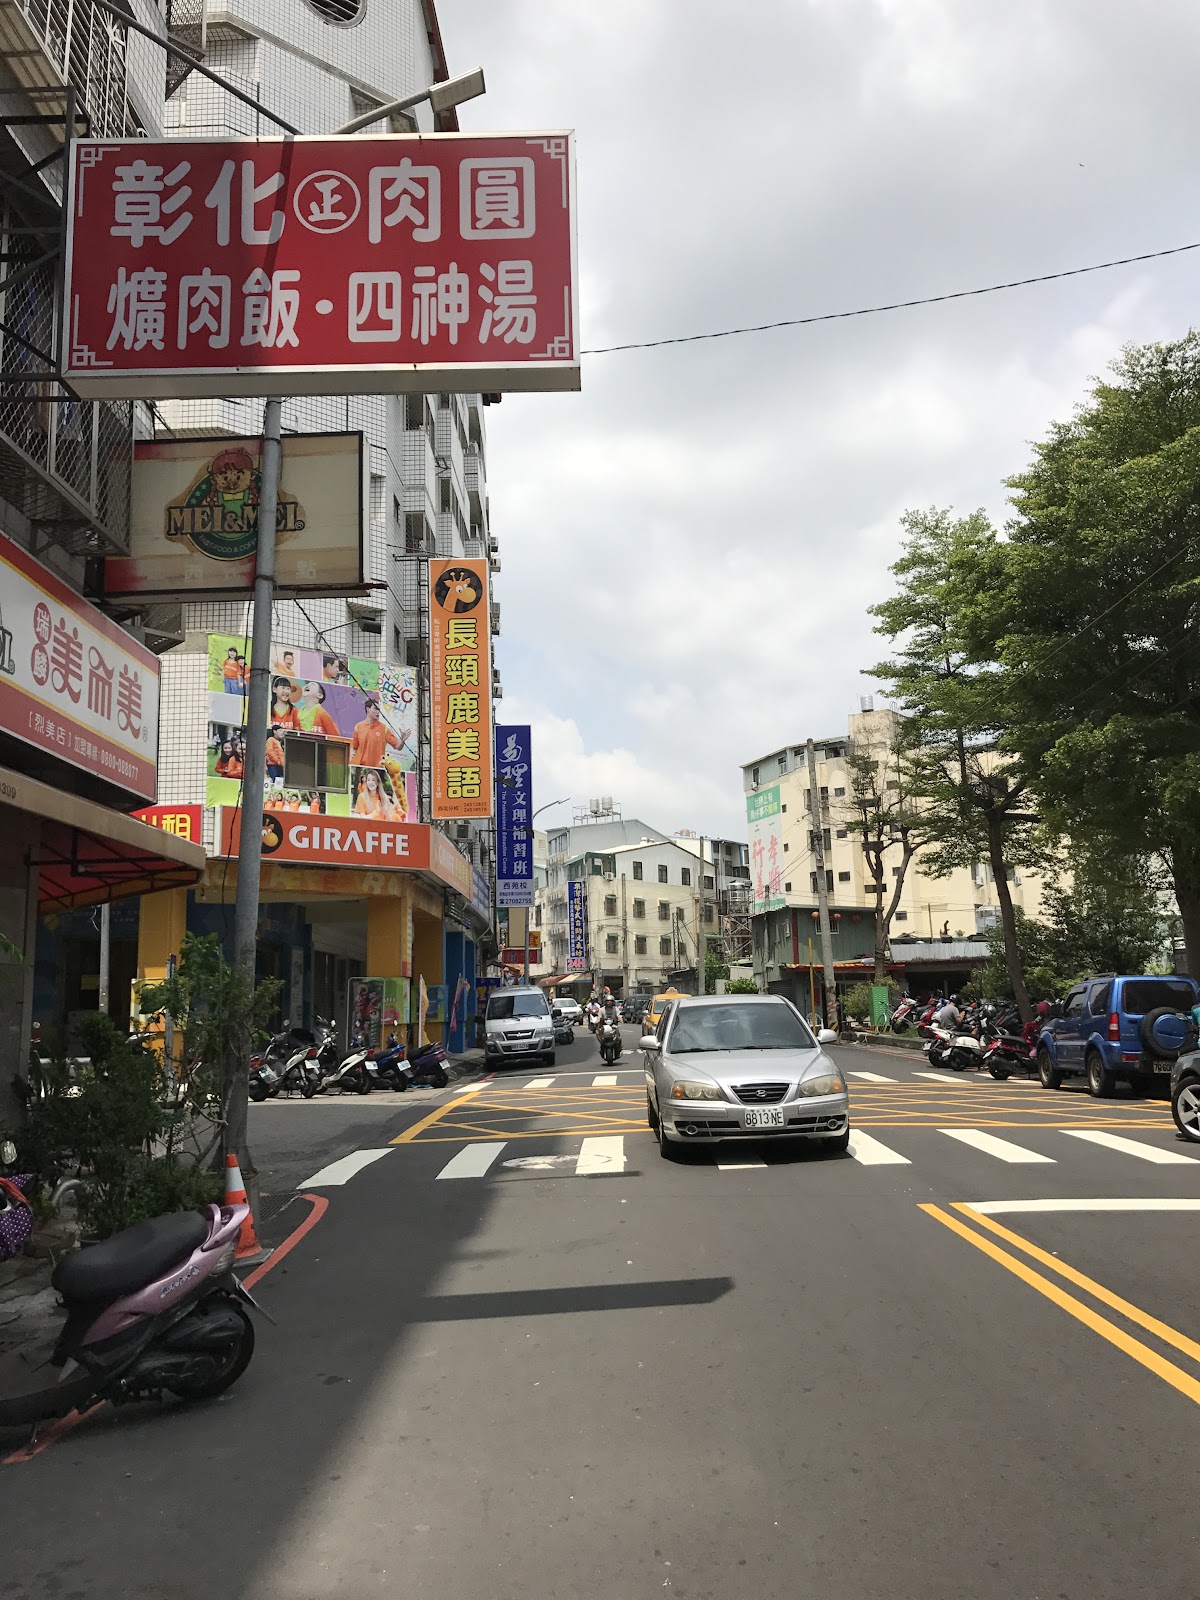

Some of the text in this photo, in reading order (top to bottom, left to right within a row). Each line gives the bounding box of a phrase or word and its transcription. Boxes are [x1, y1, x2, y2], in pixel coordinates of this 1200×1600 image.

[51, 617, 142, 740] 美而美
[444, 618, 480, 798] 長頸鹿美語
[288, 824, 409, 857] GIRAFFE
[512, 790, 527, 876] 文理補習班
